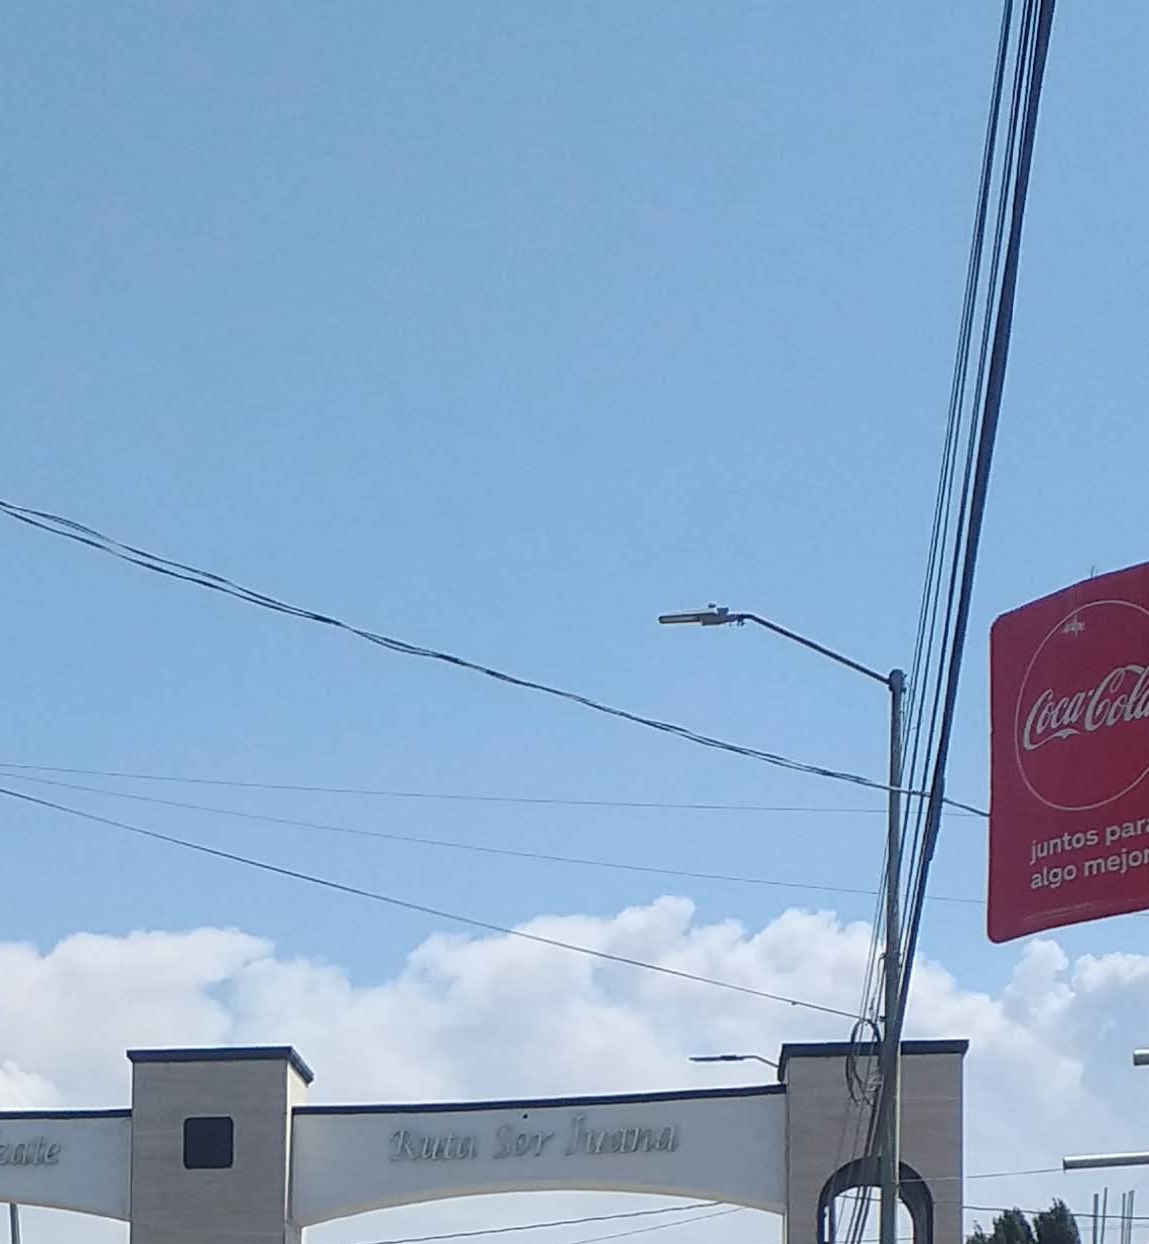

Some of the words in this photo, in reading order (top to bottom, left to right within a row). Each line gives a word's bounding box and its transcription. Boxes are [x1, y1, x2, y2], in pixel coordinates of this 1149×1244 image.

[1029, 830, 1098, 865] juntos
[1105, 818, 1149, 846] par
[1030, 865, 1077, 889] algo
[388, 1128, 477, 1162] Ruta
[491, 1122, 555, 1160] Sor
[565, 1112, 680, 1157] Juana
